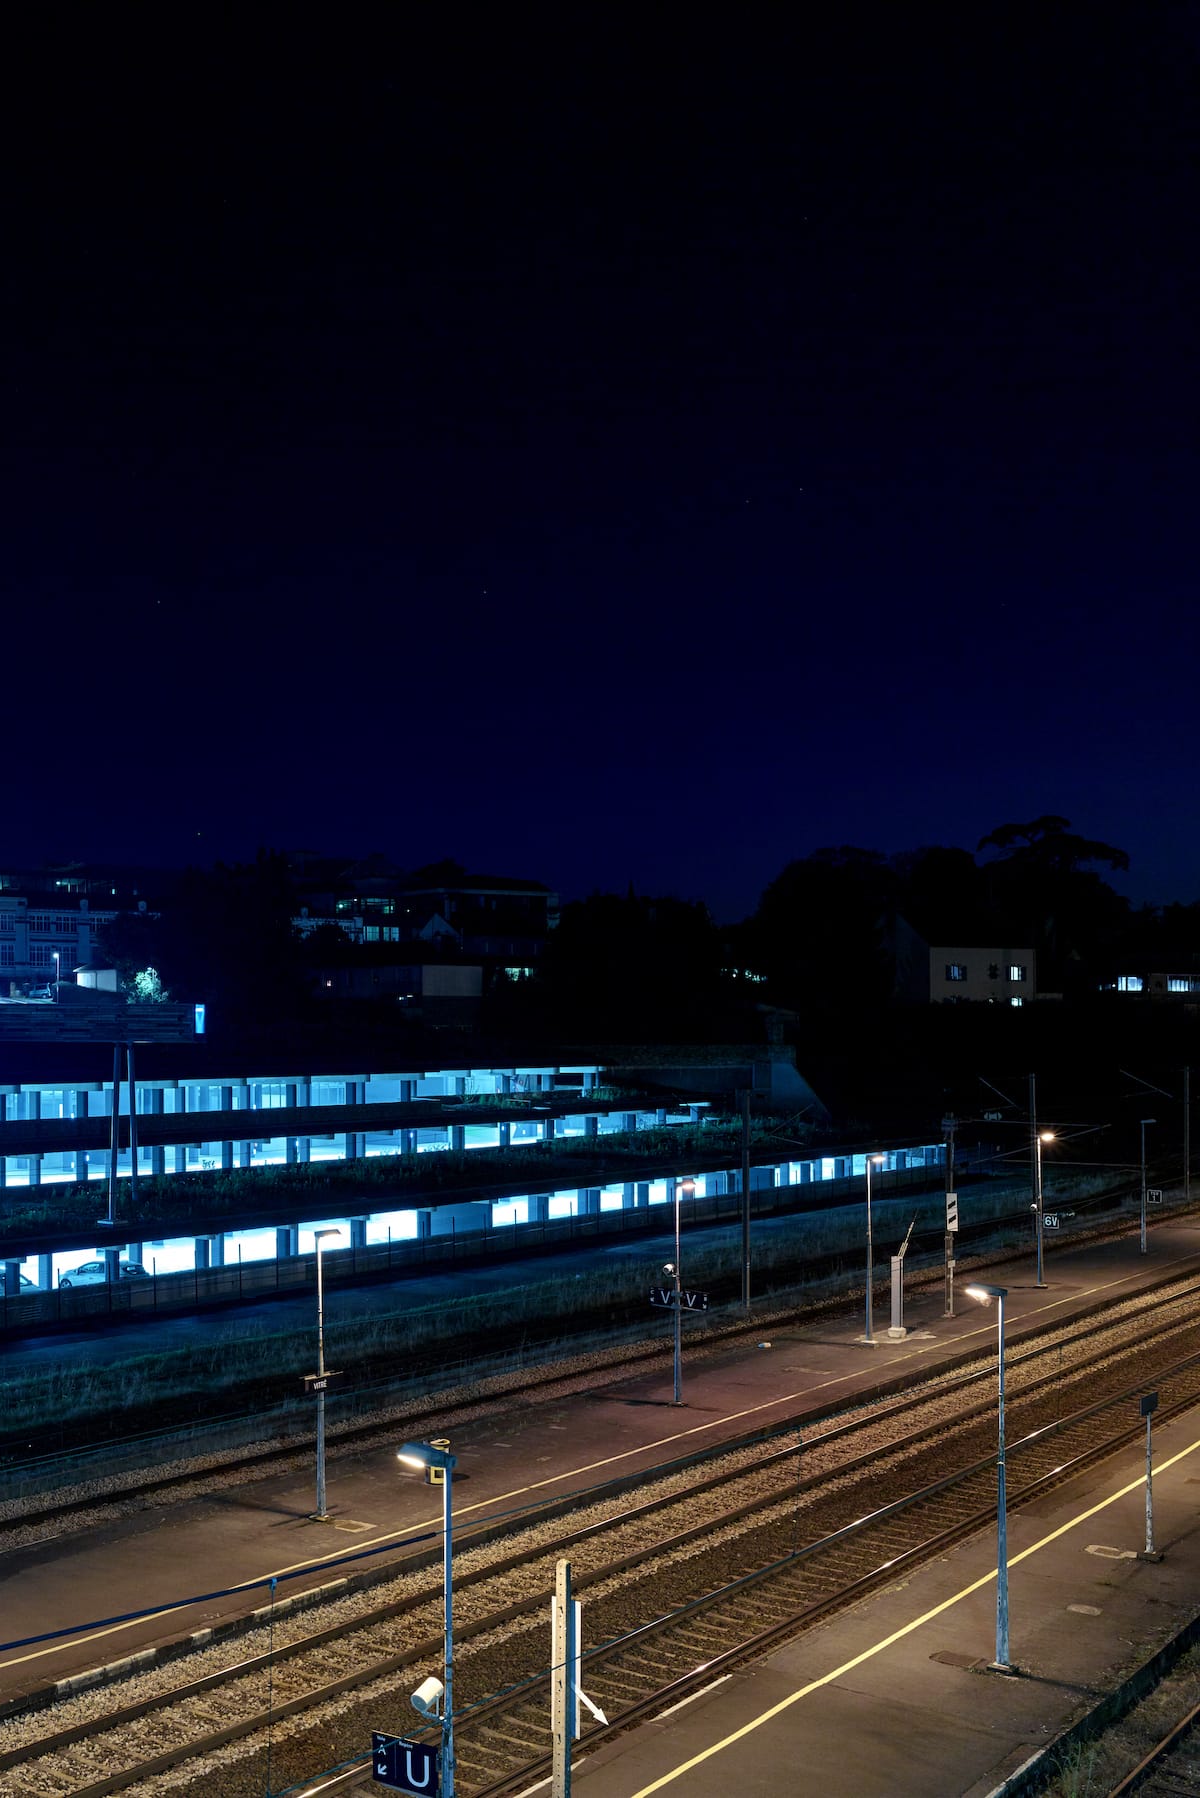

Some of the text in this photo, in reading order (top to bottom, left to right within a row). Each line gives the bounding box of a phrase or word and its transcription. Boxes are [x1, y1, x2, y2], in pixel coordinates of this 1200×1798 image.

[1044, 1215, 1058, 1227] 6V
[660, 1290, 671, 1304] V
[686, 1293, 697, 1308] V
[313, 1379, 328, 1390] VITRÉ
[378, 1744, 386, 1755] A
[406, 1750, 430, 1788] U
